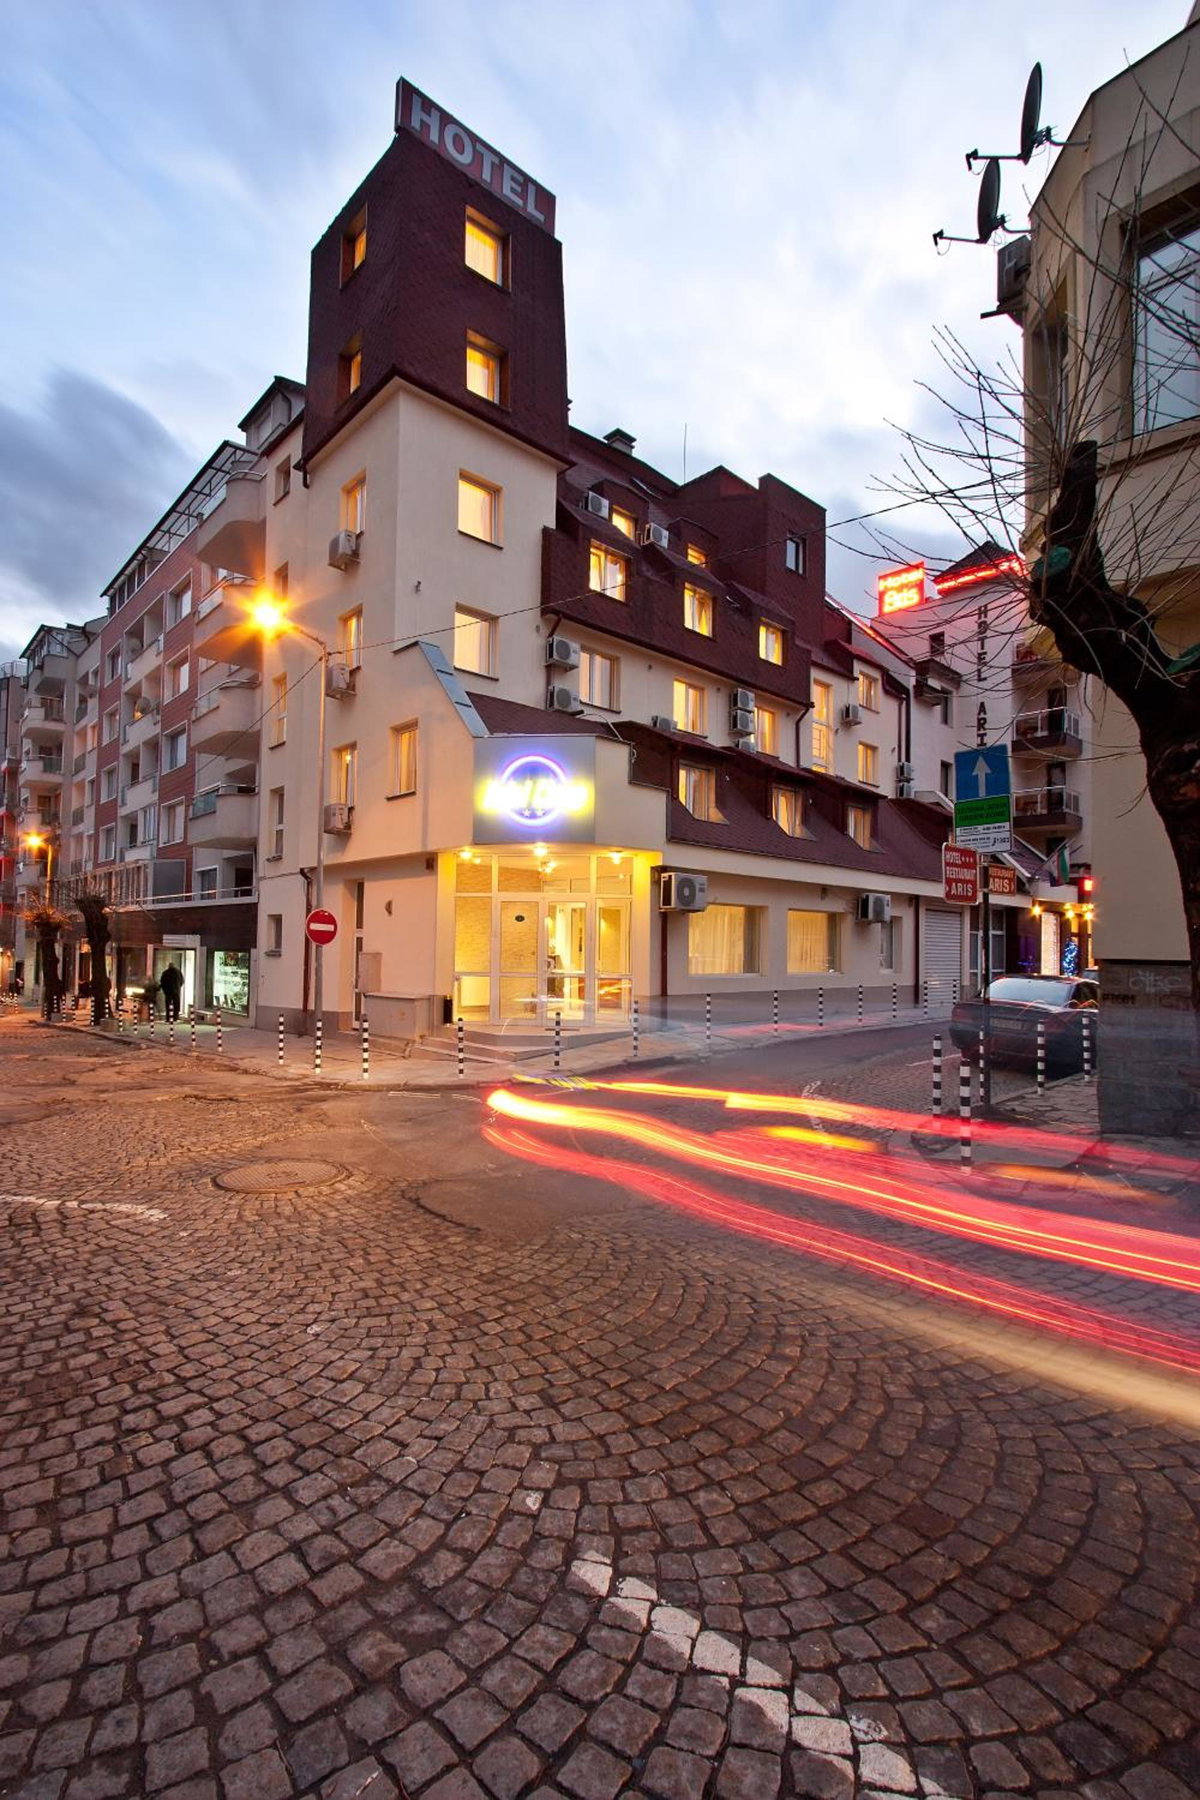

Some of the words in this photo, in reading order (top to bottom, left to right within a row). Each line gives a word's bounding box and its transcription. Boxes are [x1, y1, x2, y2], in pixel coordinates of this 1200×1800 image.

[410, 93, 545, 222] HOTEL
[977, 604, 988, 682] HOTEL
[977, 701, 987, 747] ARI
[945, 851, 961, 863] HOTEL
[951, 882, 973, 896] ARIS
[989, 878, 1009, 892] ARIS
